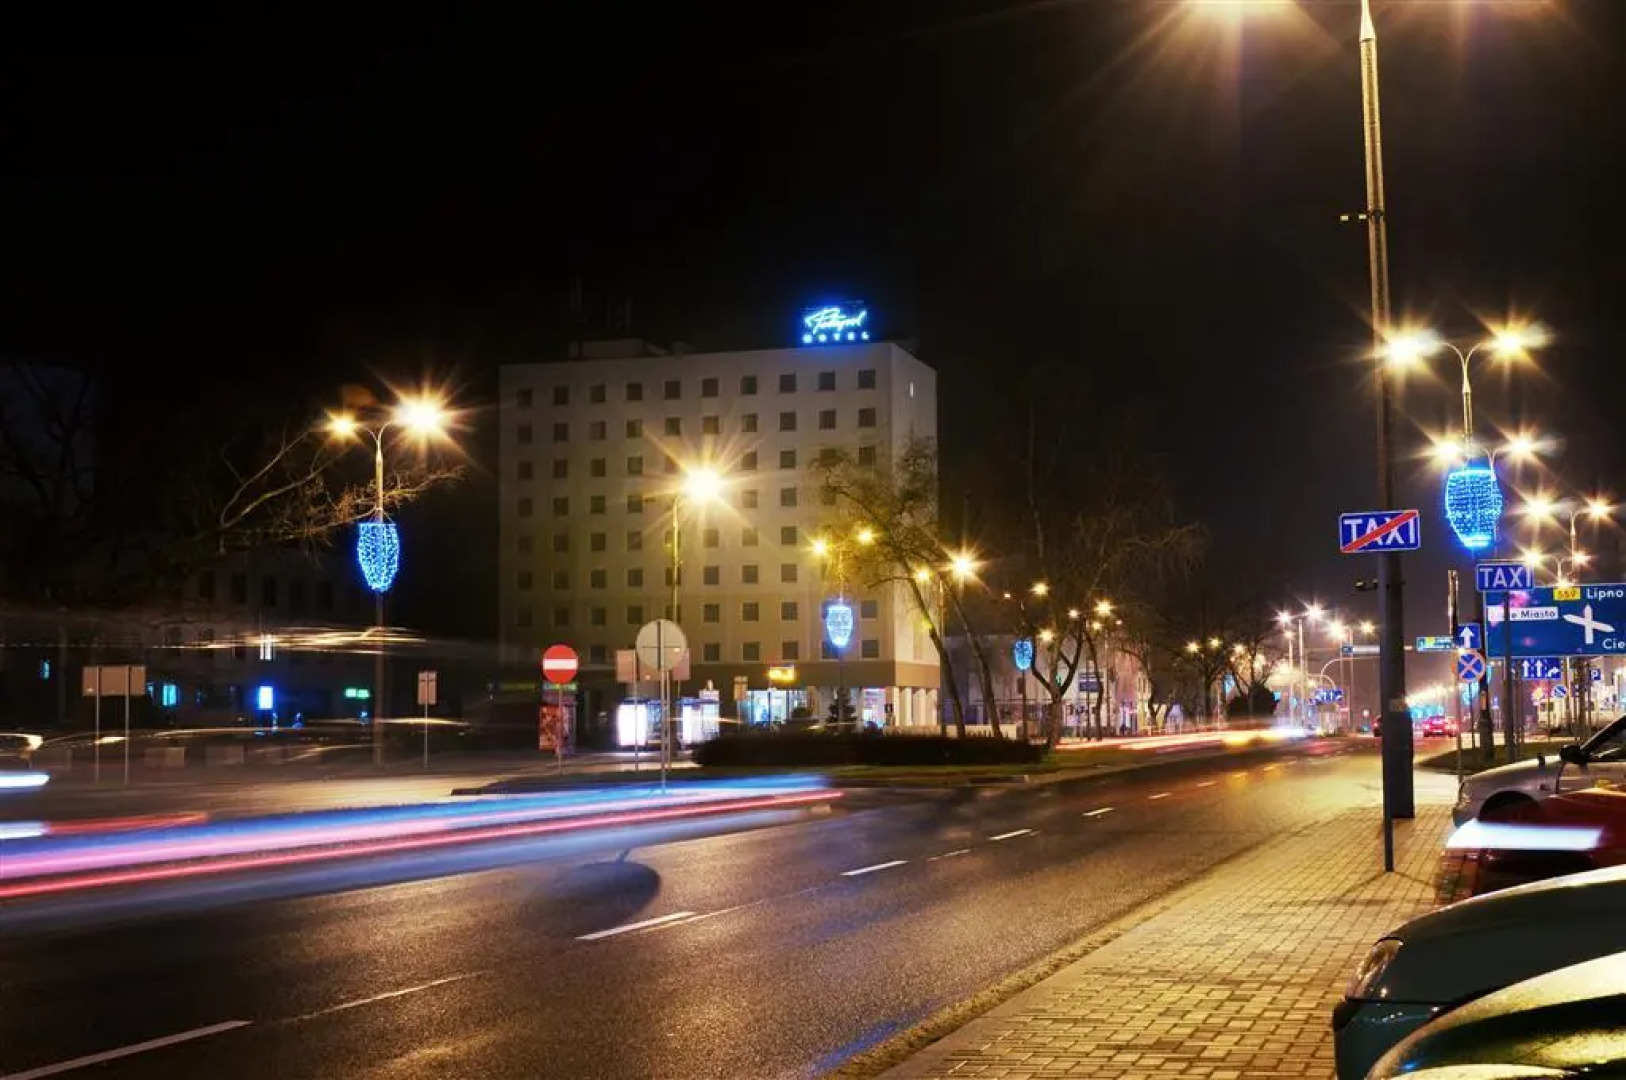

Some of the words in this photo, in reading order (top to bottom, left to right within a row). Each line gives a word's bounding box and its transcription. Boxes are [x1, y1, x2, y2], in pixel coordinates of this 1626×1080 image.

[1343, 517, 1416, 546] TAXI
[1479, 566, 1532, 588] TAXI
[1587, 587, 1624, 602] Lipno
[1520, 609, 1556, 619] Miasto
